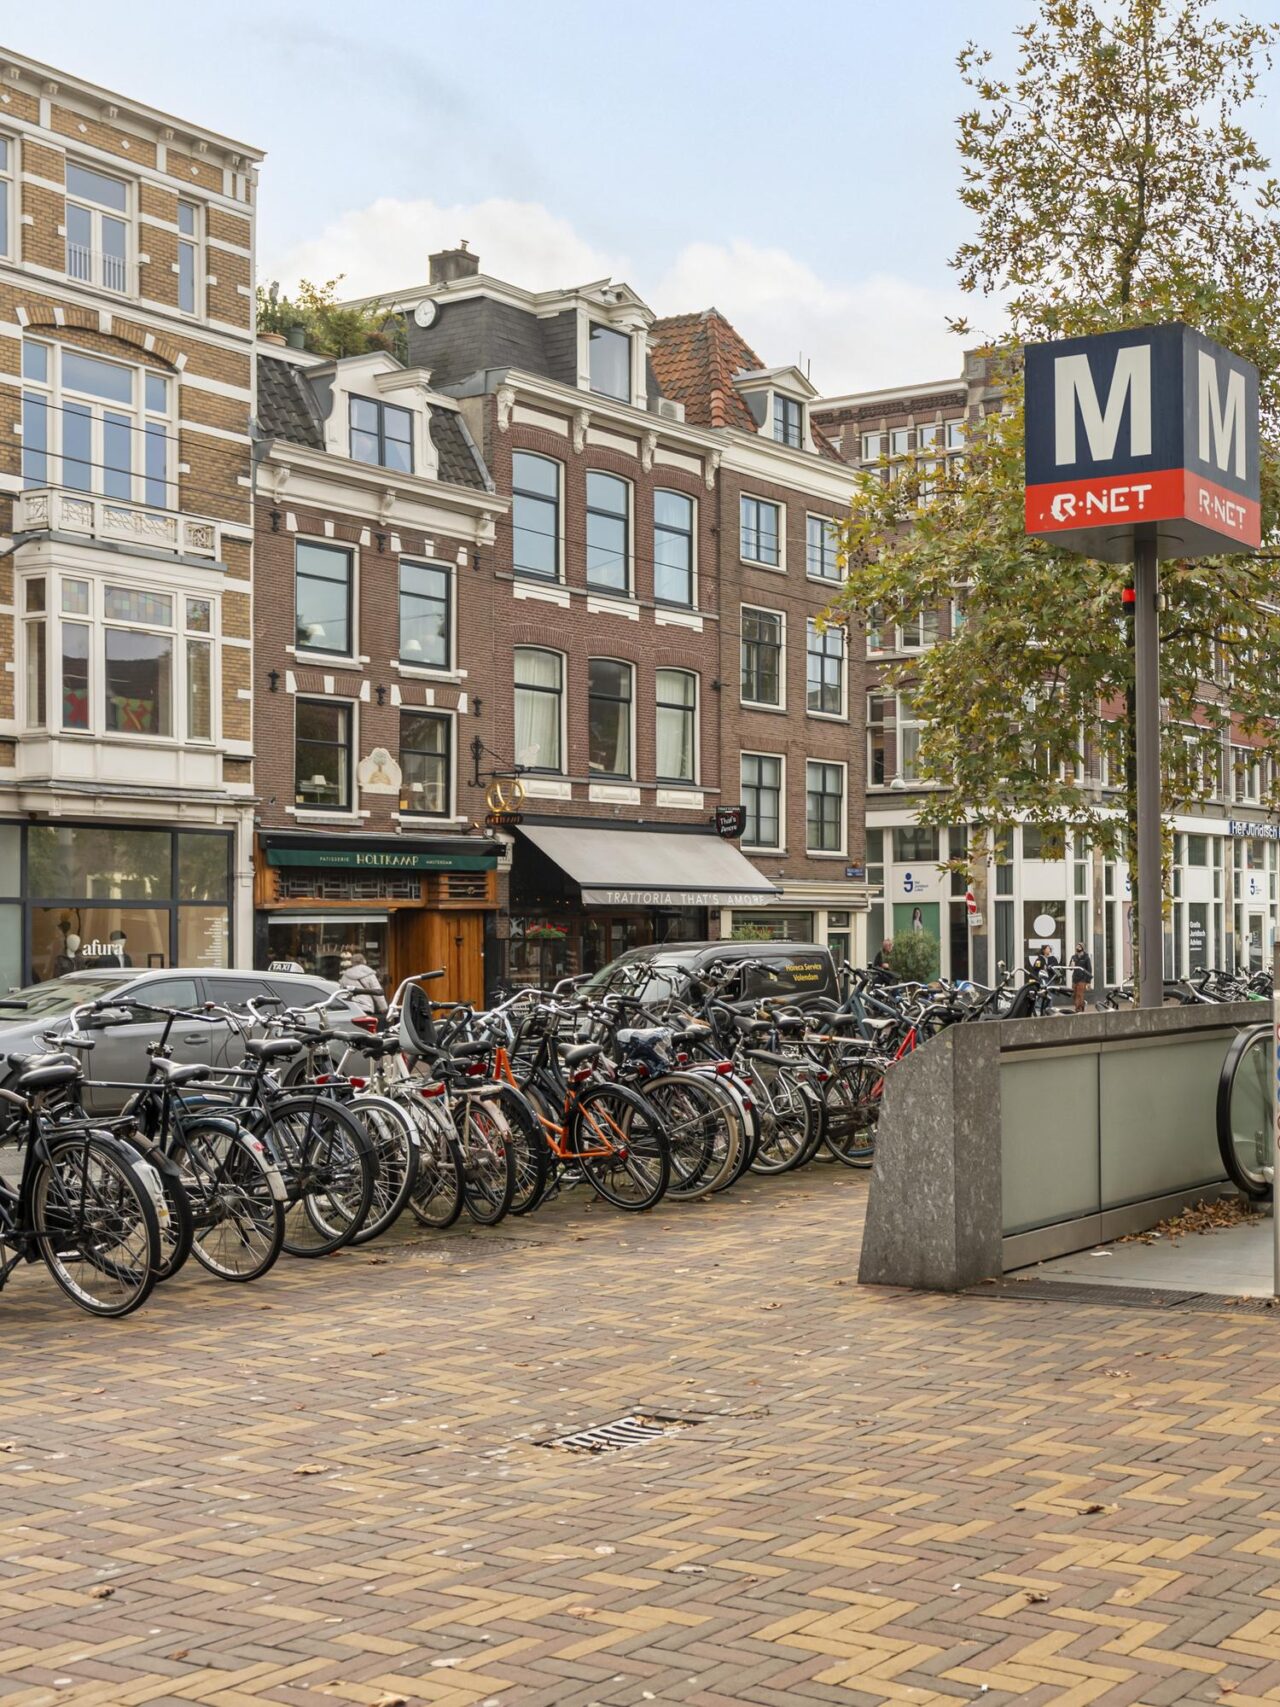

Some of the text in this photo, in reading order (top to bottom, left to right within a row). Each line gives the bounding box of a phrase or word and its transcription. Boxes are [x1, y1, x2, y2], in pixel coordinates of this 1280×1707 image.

[1054, 344, 1152, 466] M
[1198, 350, 1246, 481] M
[1247, 823, 1278, 839] Juridisch
[356, 854, 419, 866] HOLTKAMP
[607, 891, 672, 904] TRATTORIA
[681, 893, 719, 905] THAT'S
[82, 939, 123, 956] afura
[272, 963, 291, 971] TAXI
